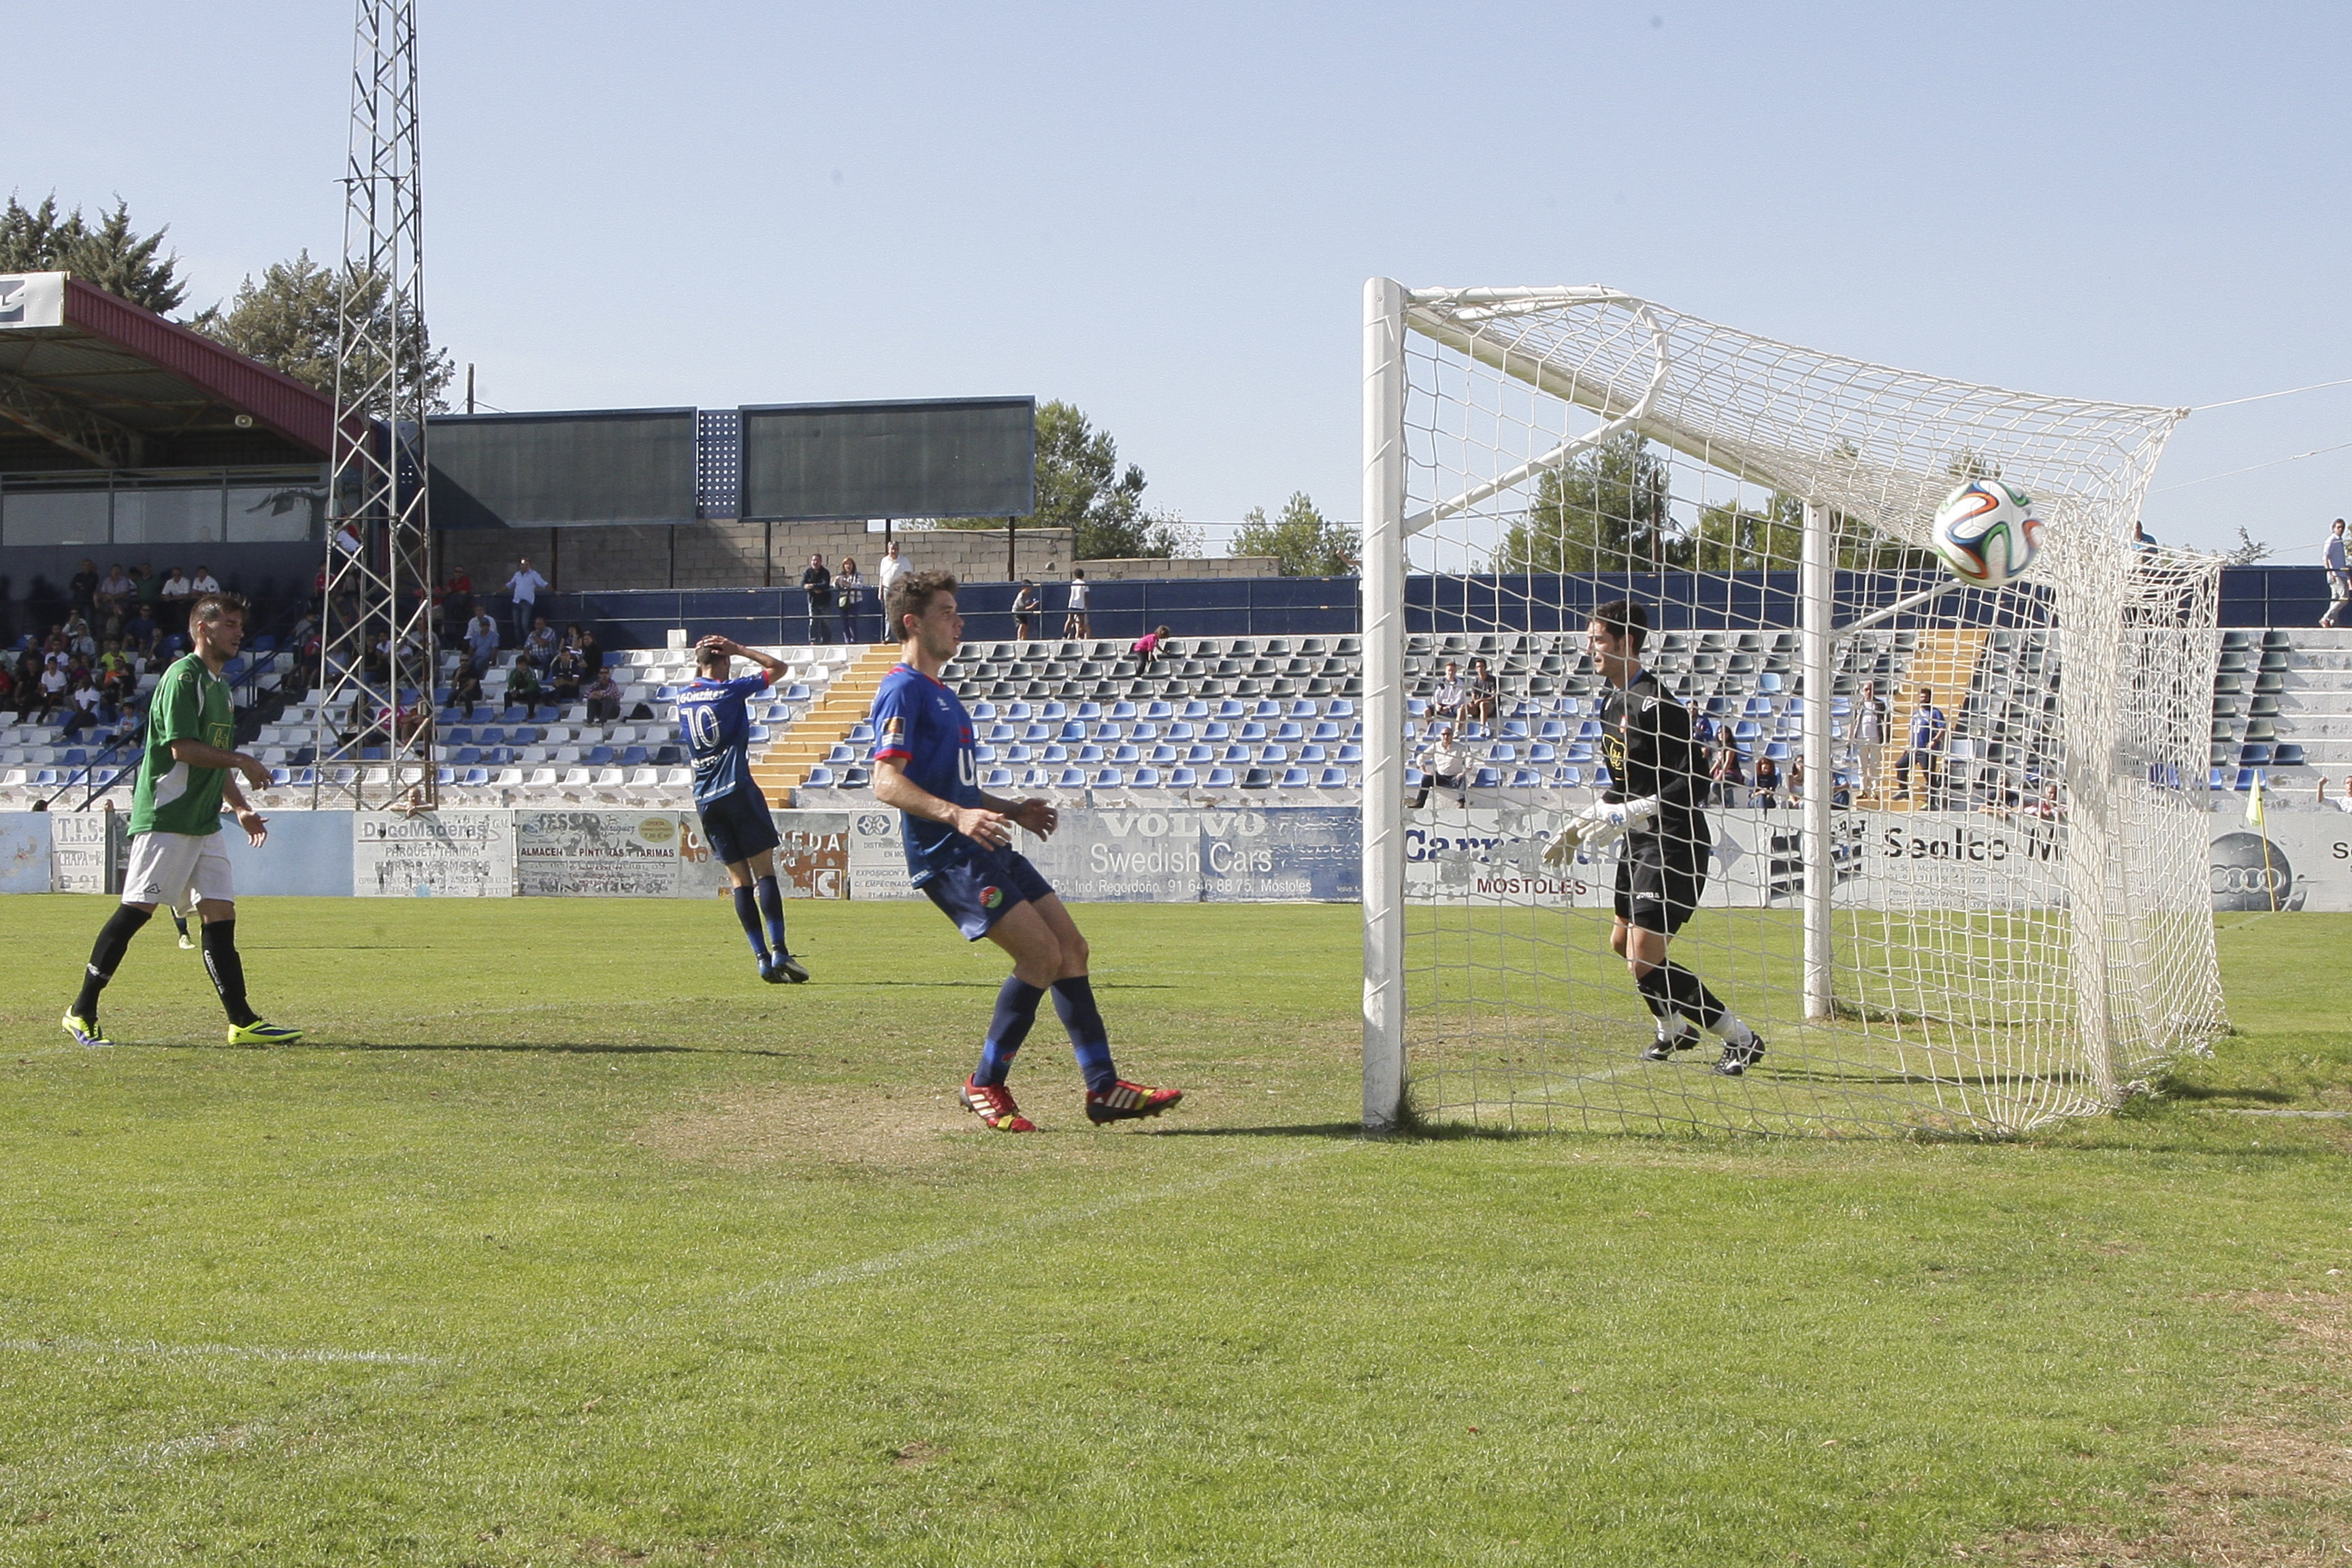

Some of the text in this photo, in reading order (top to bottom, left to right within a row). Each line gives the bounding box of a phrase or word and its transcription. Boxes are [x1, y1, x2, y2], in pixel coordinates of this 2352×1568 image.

[681, 704, 720, 750] 10
[1098, 812, 1267, 838] VOLVO
[521, 847, 563, 856] ALMACEN
[1090, 841, 1273, 874] Swedish Cars
[1884, 827, 2010, 862] Sealco
[1168, 879, 1183, 893] 91
[1261, 878, 1313, 893] Móstoles
[1477, 877, 1588, 896] MOSTOLES
